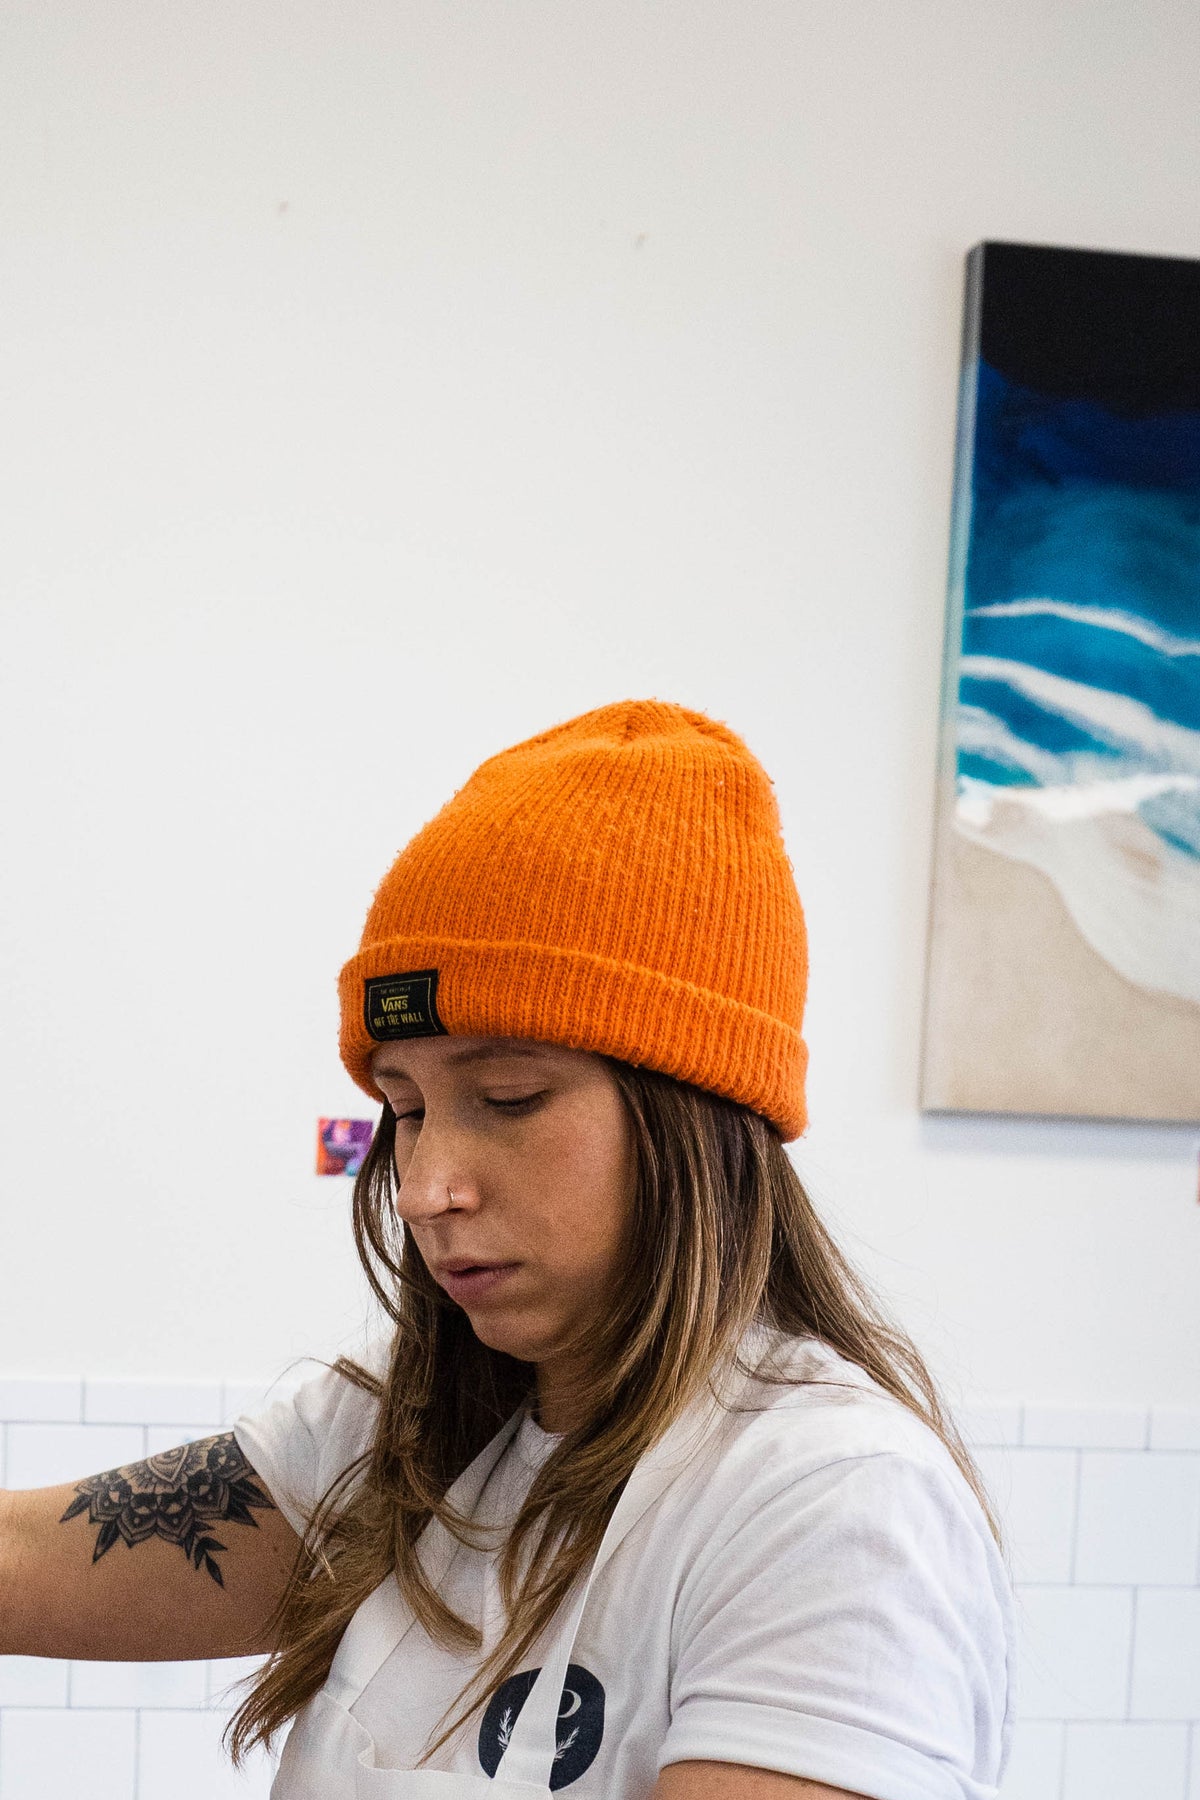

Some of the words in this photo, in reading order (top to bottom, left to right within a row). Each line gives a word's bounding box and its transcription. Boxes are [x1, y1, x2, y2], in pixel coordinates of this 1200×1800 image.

[381, 995, 409, 1013] VANS
[373, 1017, 386, 1028] OFF
[386, 1013, 400, 1026] THE
[400, 1011, 426, 1024] WALL
